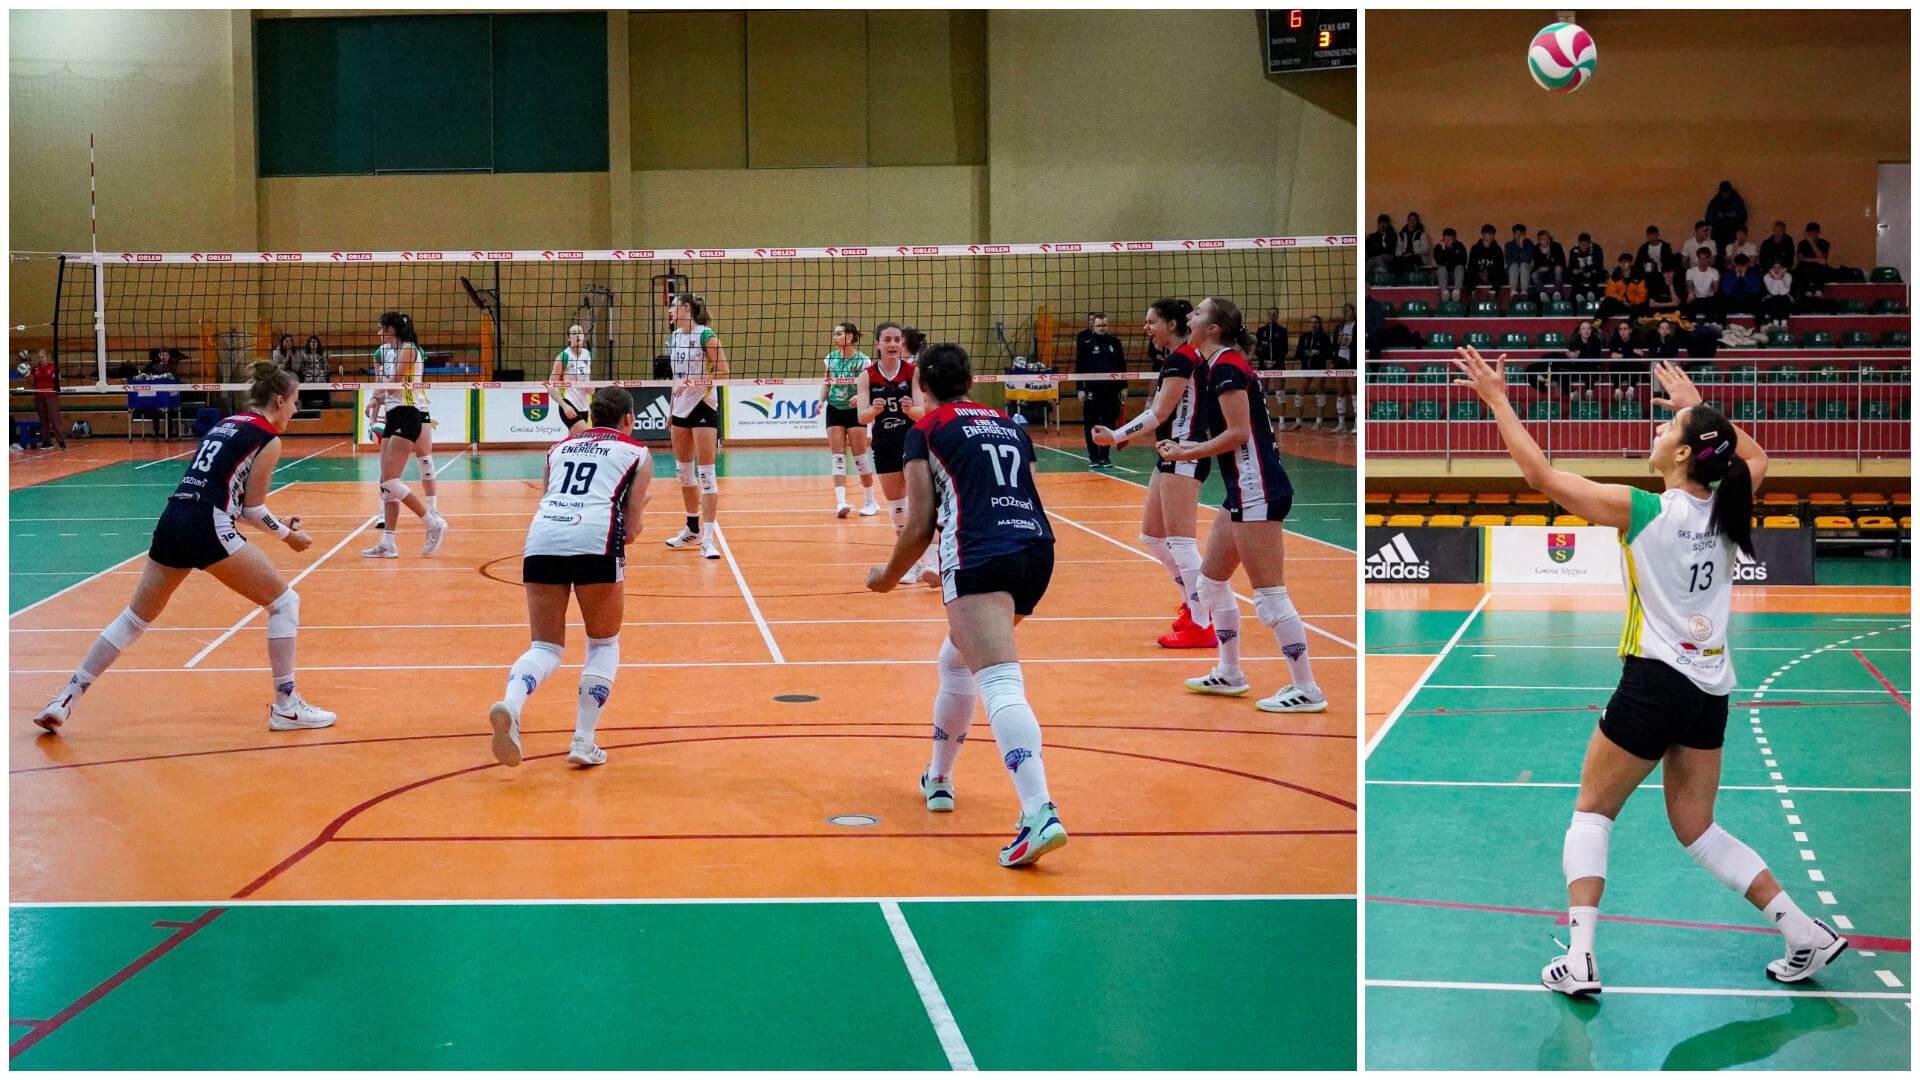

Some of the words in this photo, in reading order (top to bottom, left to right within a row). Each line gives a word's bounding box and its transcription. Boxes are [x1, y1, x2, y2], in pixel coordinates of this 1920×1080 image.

[1291, 10, 1302, 28] 6
[1319, 31, 1330, 47] 3
[677, 352, 686, 364] 19
[771, 400, 819, 420] SMS
[887, 397, 898, 412] 5
[633, 417, 666, 430] adid
[974, 419, 1000, 427] ENEA
[962, 425, 1020, 441] ENERGETYK
[192, 440, 222, 473] 13
[561, 445, 611, 457] ENERGETYK
[980, 443, 1021, 488] 17
[560, 461, 598, 496] 19
[1678, 529, 1692, 539] GKS
[1689, 560, 1714, 592] 13
[1732, 562, 1768, 580] das
